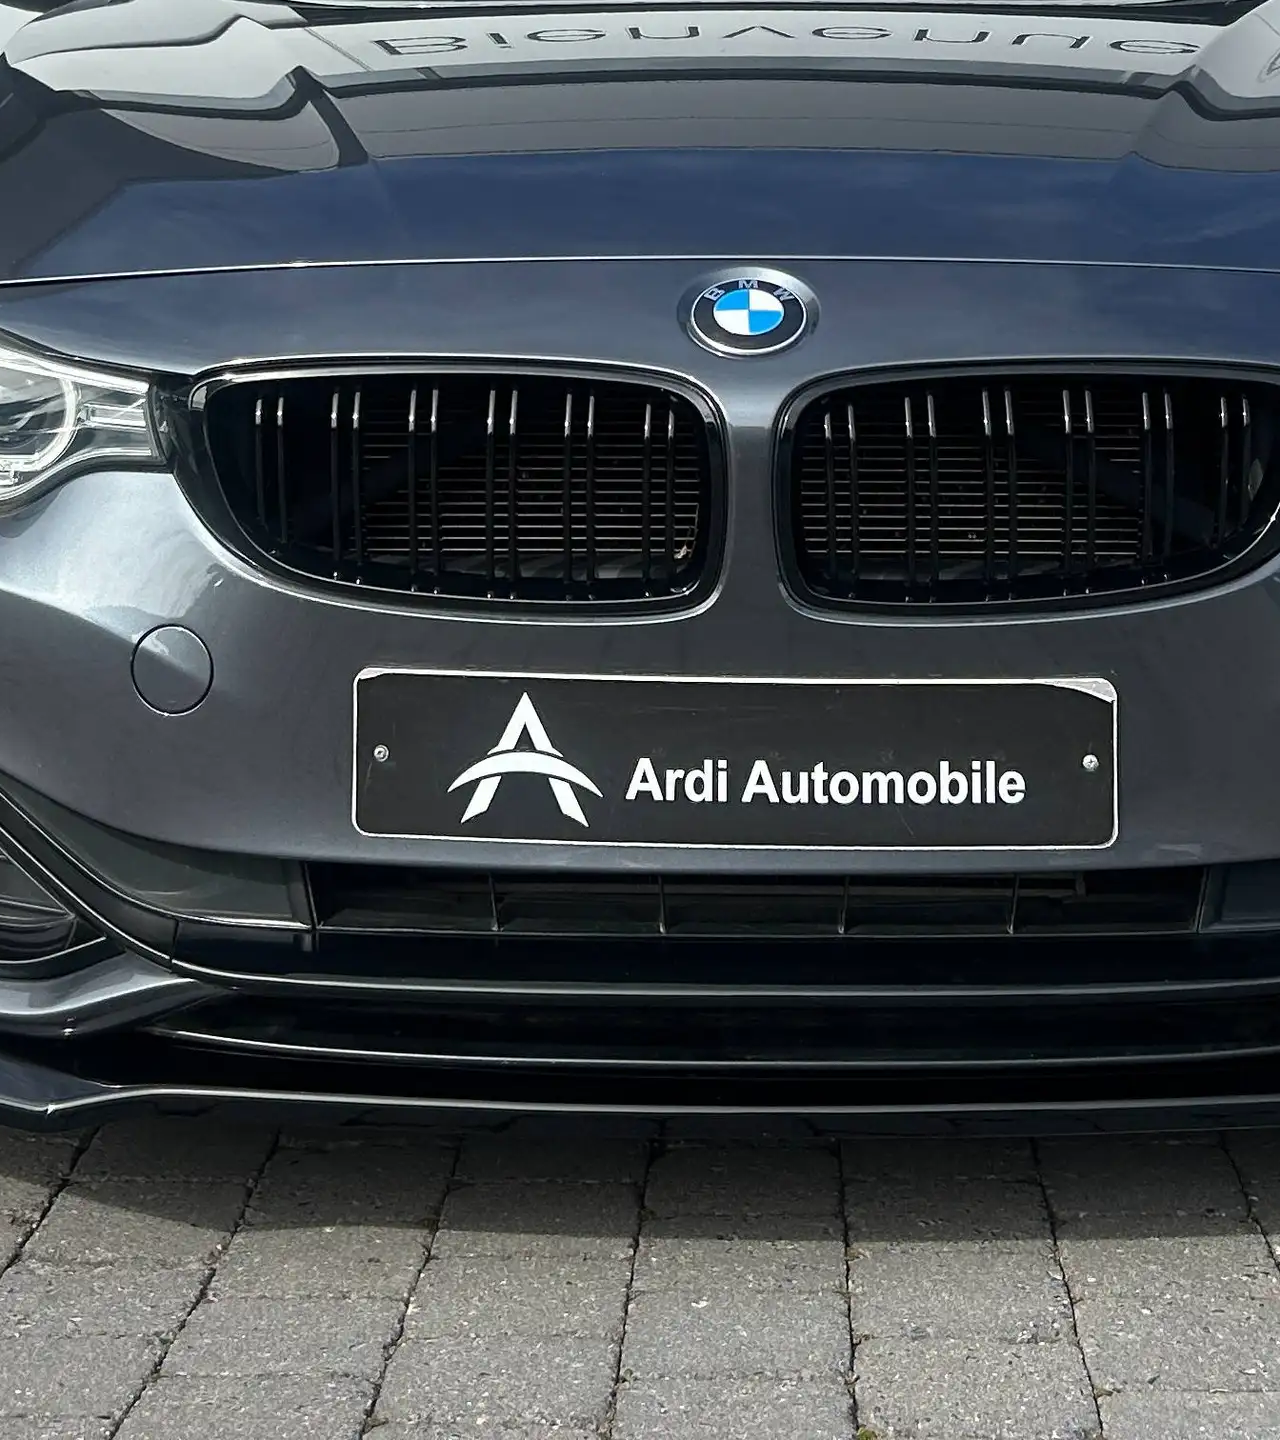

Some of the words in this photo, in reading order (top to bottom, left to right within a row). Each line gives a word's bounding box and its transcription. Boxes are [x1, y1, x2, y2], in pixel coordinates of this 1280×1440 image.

[703, 278, 796, 302] BMW
[624, 757, 729, 804] Ardi
[740, 759, 1027, 806] Automobile
